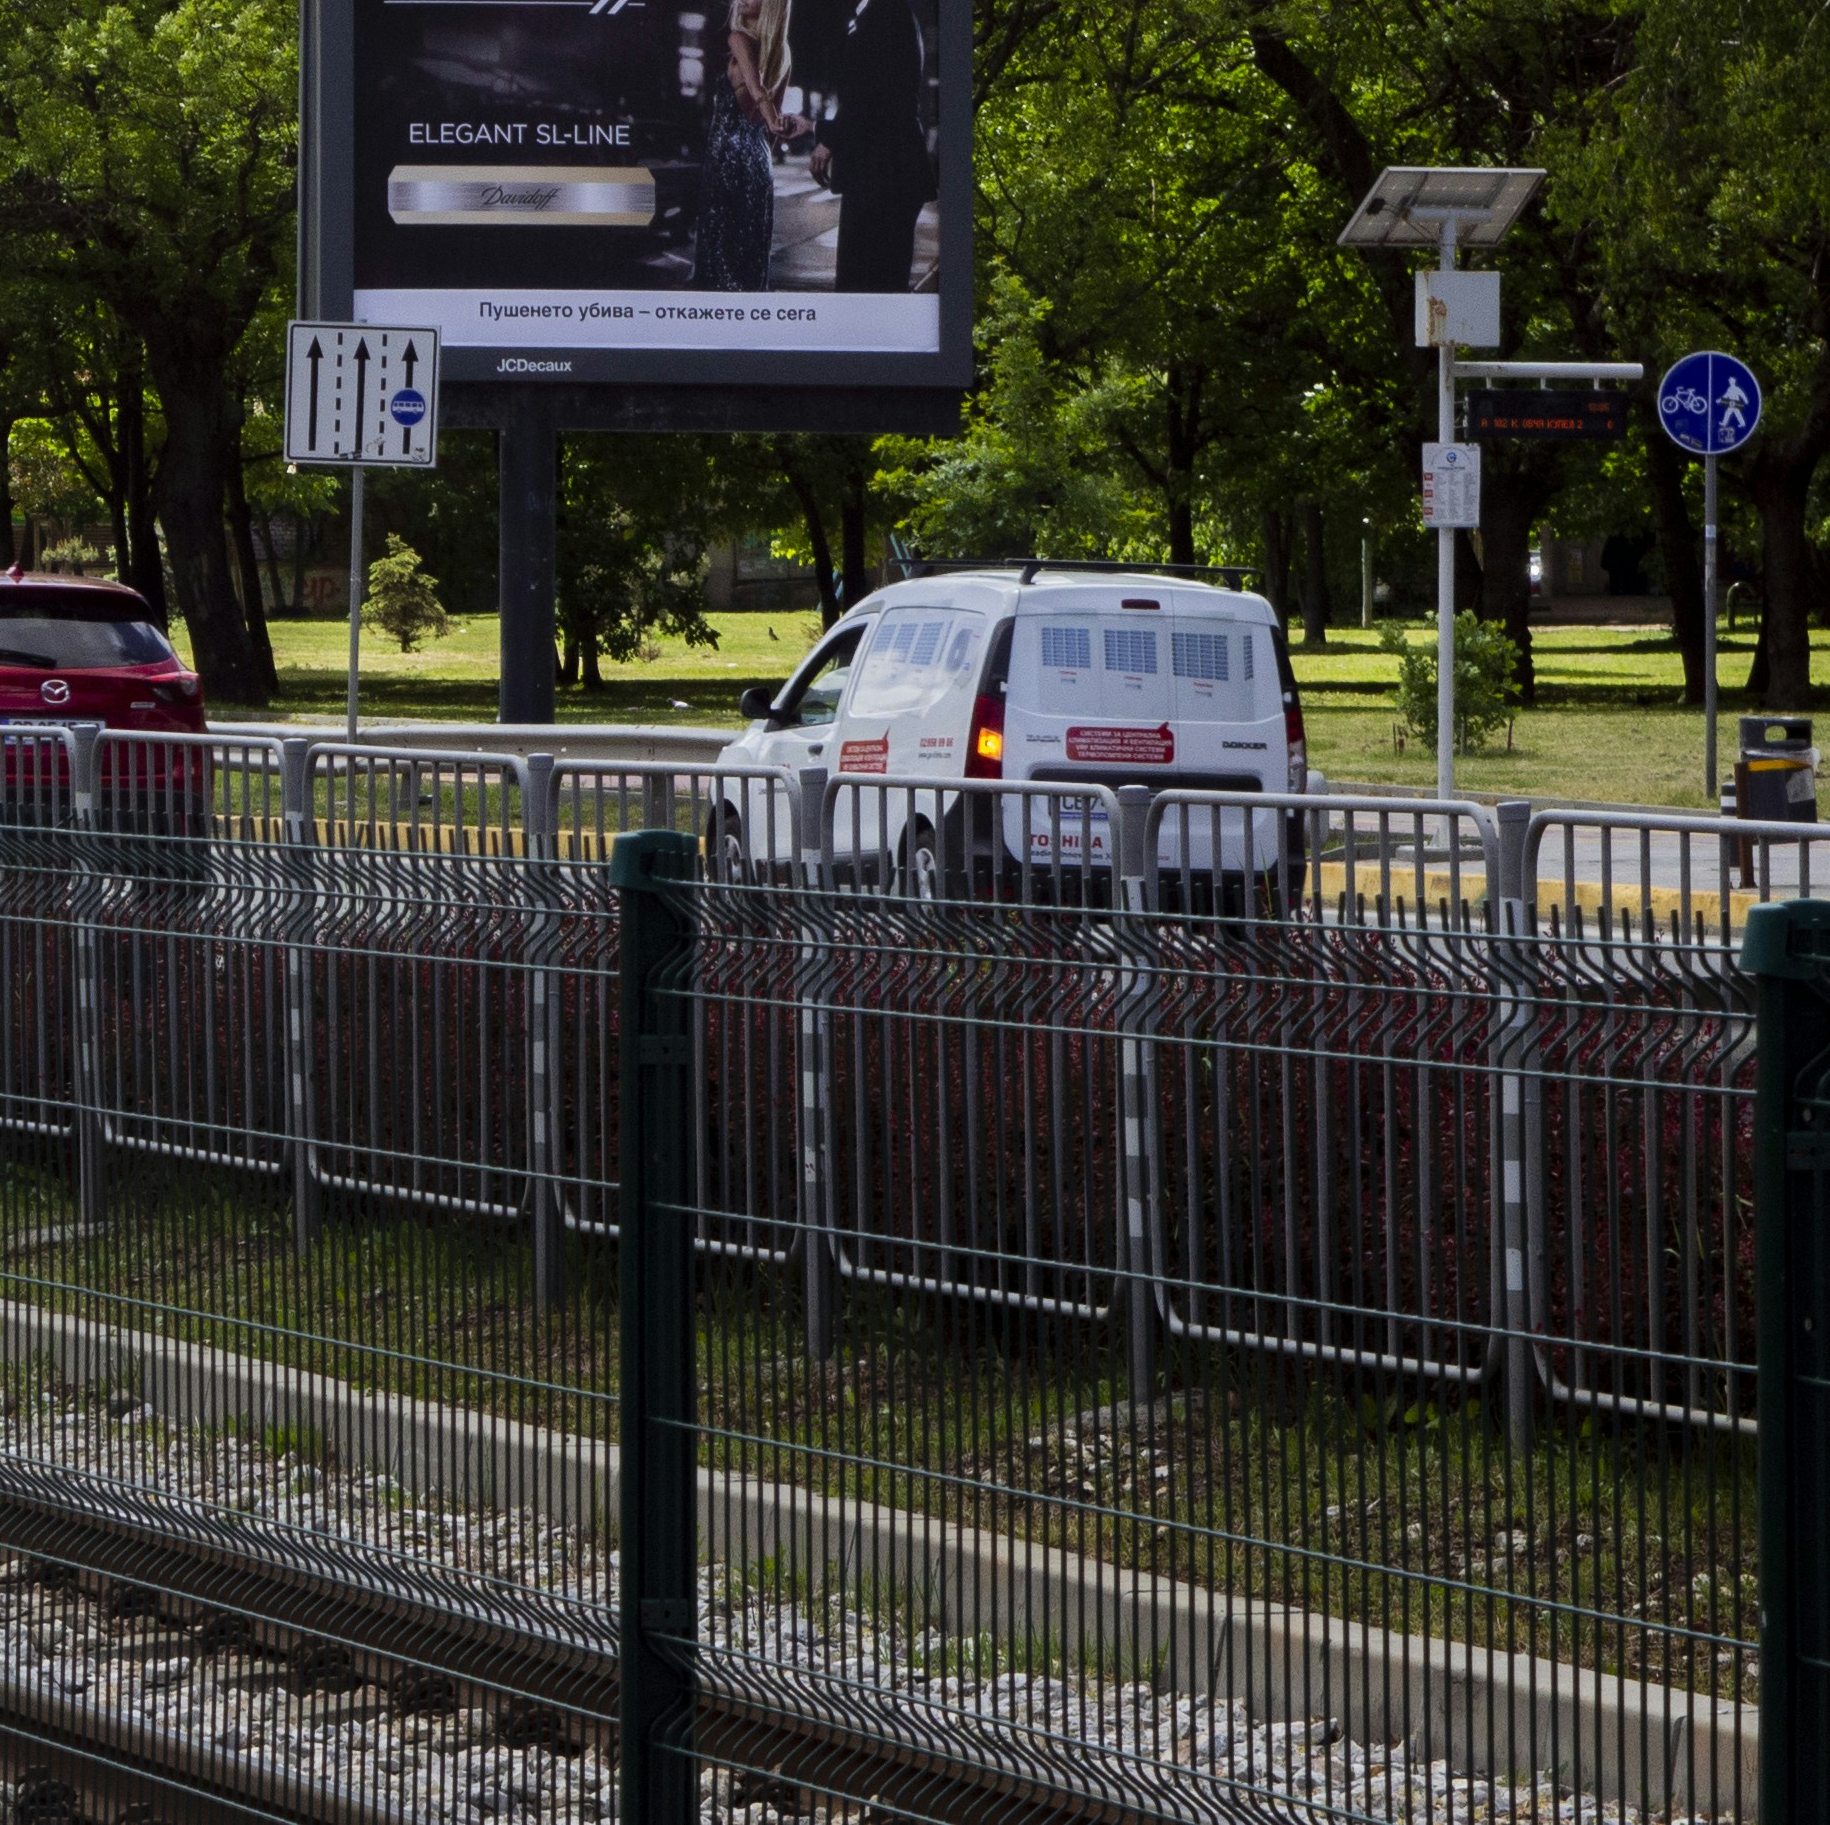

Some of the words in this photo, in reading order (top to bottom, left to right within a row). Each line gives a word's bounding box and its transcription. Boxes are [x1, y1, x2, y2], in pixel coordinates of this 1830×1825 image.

[409, 123, 528, 144] ELEGANT
[536, 124, 631, 146] SL-LINE
[481, 186, 561, 210] Davidoff
[479, 301, 573, 321] Пушенето
[579, 303, 634, 322] убива
[655, 307, 745, 321] откажете
[750, 309, 771, 321] се
[776, 309, 816, 321] сега
[496, 358, 572, 373] JCDecaux
[1029, 833, 1103, 848] TOHIA
